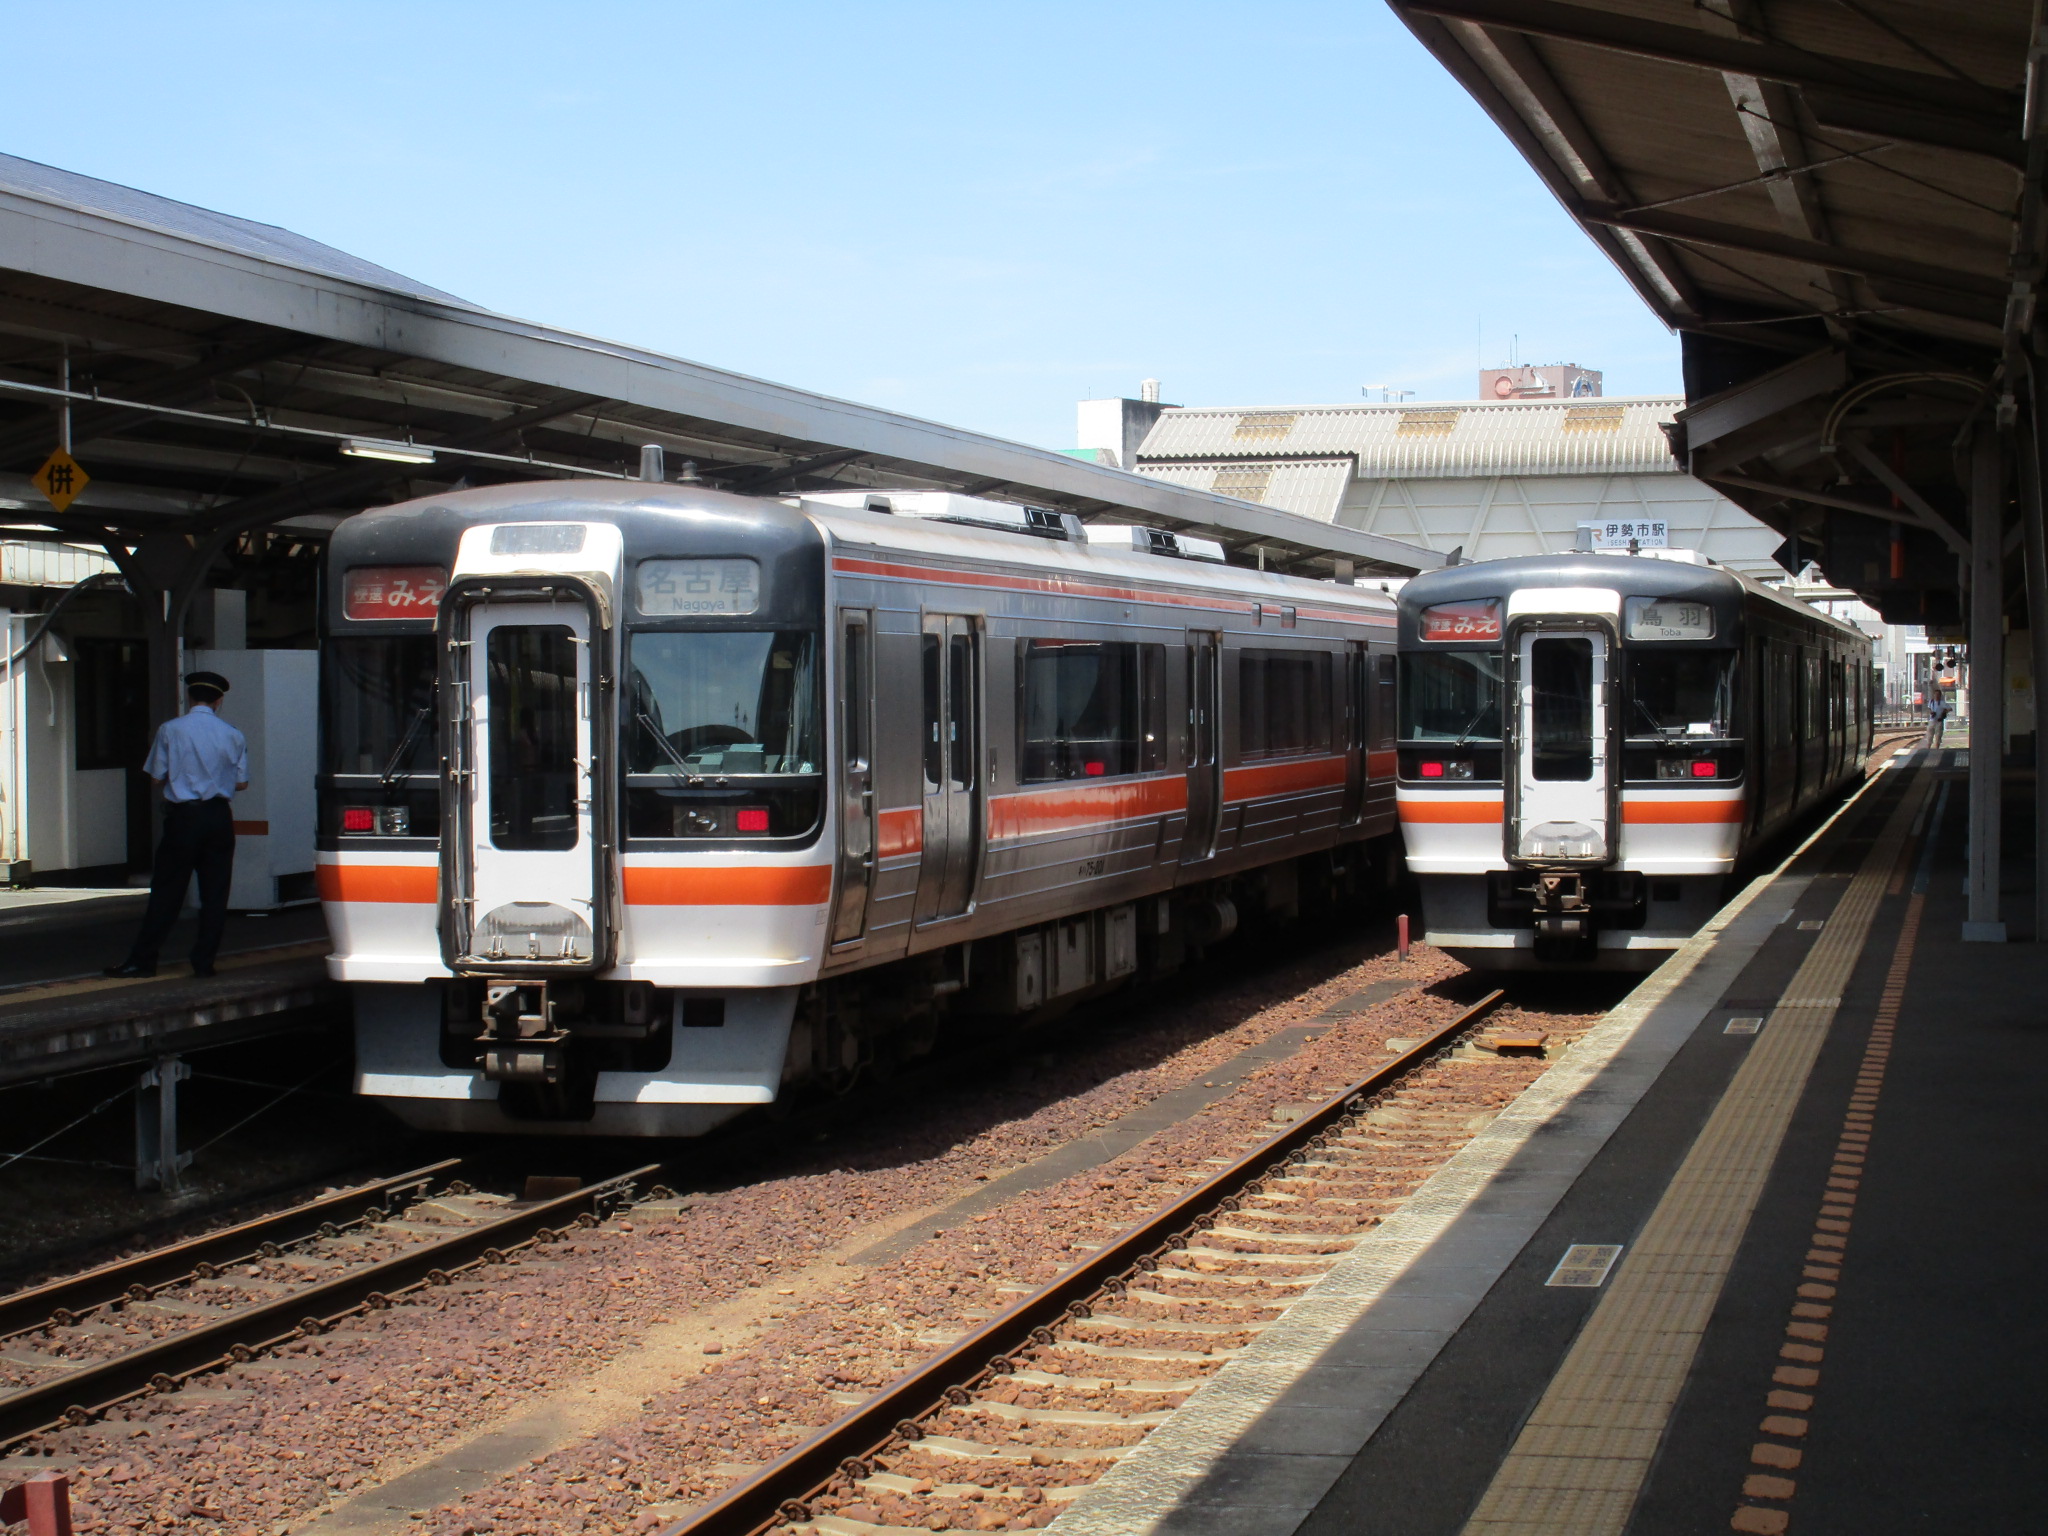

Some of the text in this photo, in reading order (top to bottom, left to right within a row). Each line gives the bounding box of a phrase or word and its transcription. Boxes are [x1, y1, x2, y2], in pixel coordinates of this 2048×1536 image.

[47, 463, 75, 496] 併
[1605, 523, 1665, 538] 伊勢市駅
[645, 563, 755, 594] 名古屋
[388, 579, 445, 607] みえ
[672, 597, 726, 613] Nagoya
[1454, 615, 1499, 634] みえ
[1640, 607, 1701, 626] 鳥羽
[1660, 627, 1682, 637] Toba
